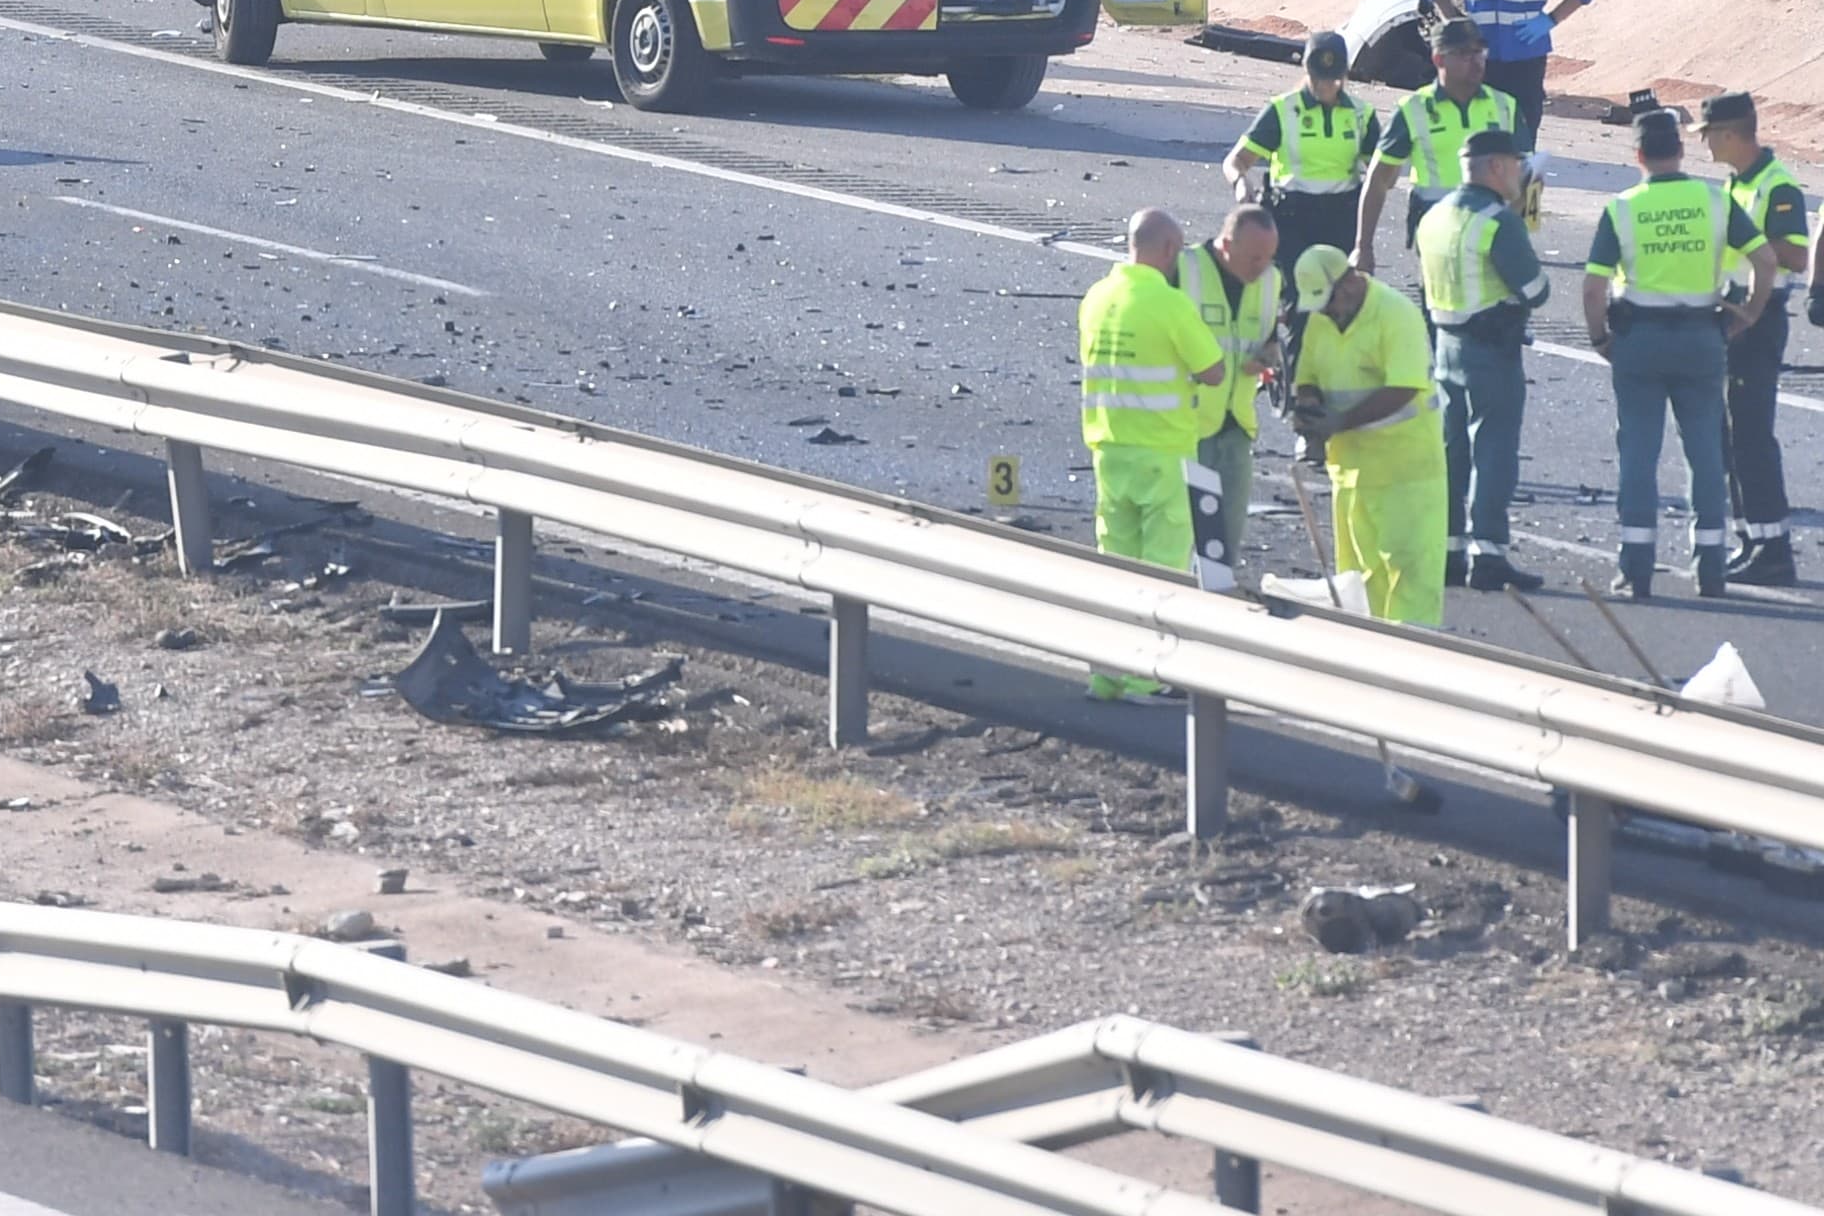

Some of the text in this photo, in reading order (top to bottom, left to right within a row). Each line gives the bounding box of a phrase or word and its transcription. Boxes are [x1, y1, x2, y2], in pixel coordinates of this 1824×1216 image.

[1637, 207, 1706, 224] GUARDIA
[1655, 223, 1690, 237] CIVIL
[994, 461, 1013, 496] 3
